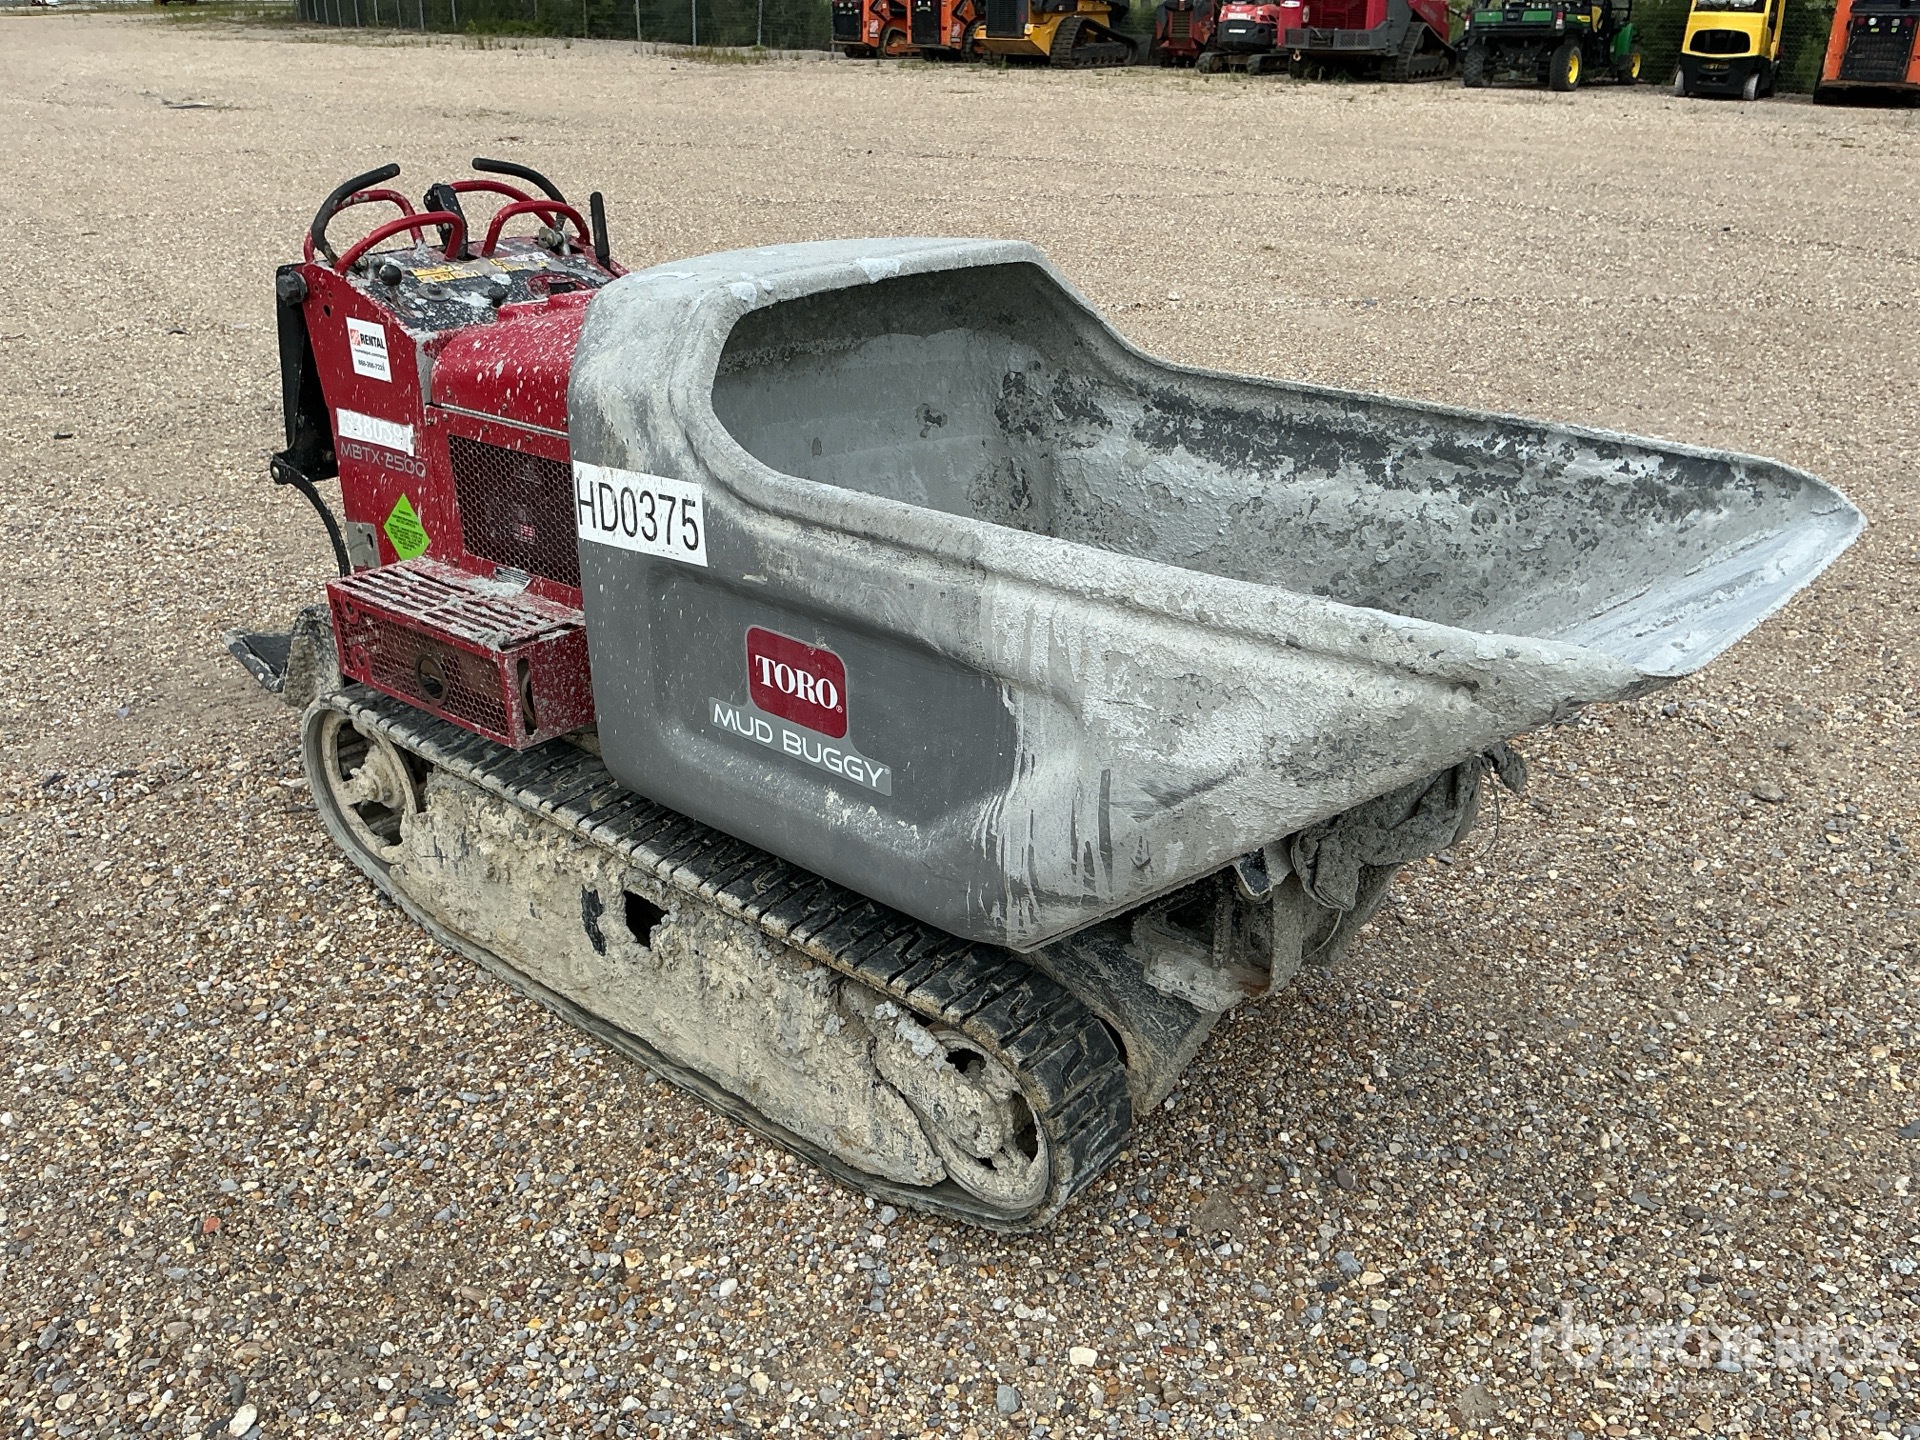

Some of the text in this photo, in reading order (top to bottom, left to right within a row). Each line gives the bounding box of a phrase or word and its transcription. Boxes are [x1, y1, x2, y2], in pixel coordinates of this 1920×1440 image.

[360, 333, 385, 349] RENTAL
[576, 477, 699, 550] HD0375
[755, 655, 838, 709] TORO
[713, 704, 884, 787] MUD BUGGY
